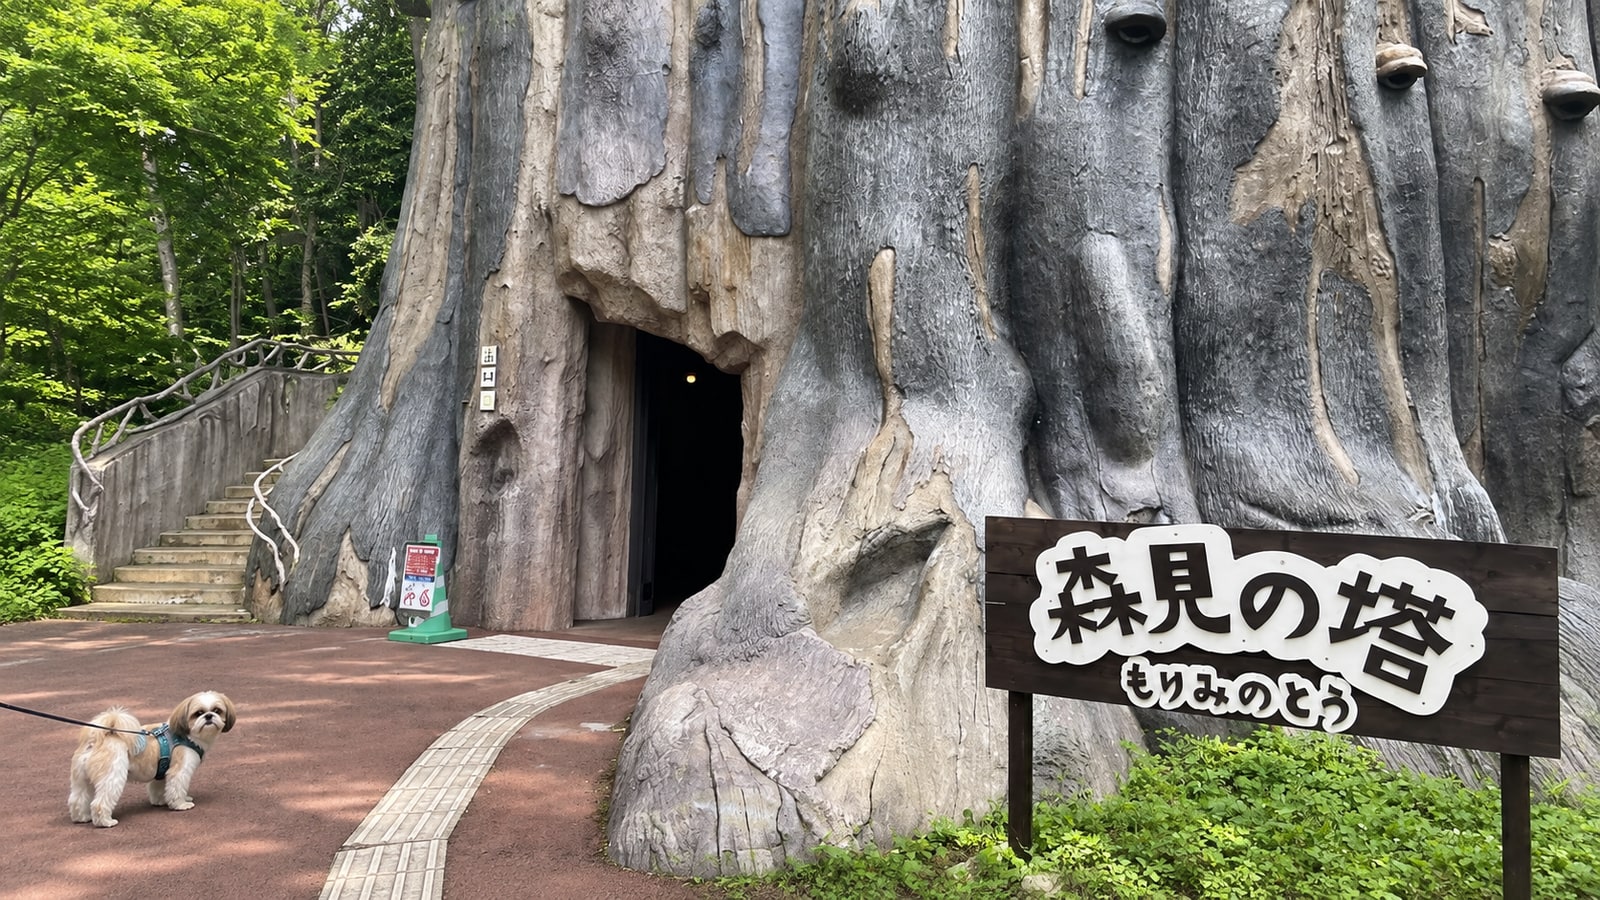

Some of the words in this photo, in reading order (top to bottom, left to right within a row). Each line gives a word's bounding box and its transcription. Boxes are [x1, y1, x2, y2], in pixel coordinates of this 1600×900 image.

[1048, 543, 1456, 694] 森見の塔
[1127, 663, 1349, 726] もりみのとう
